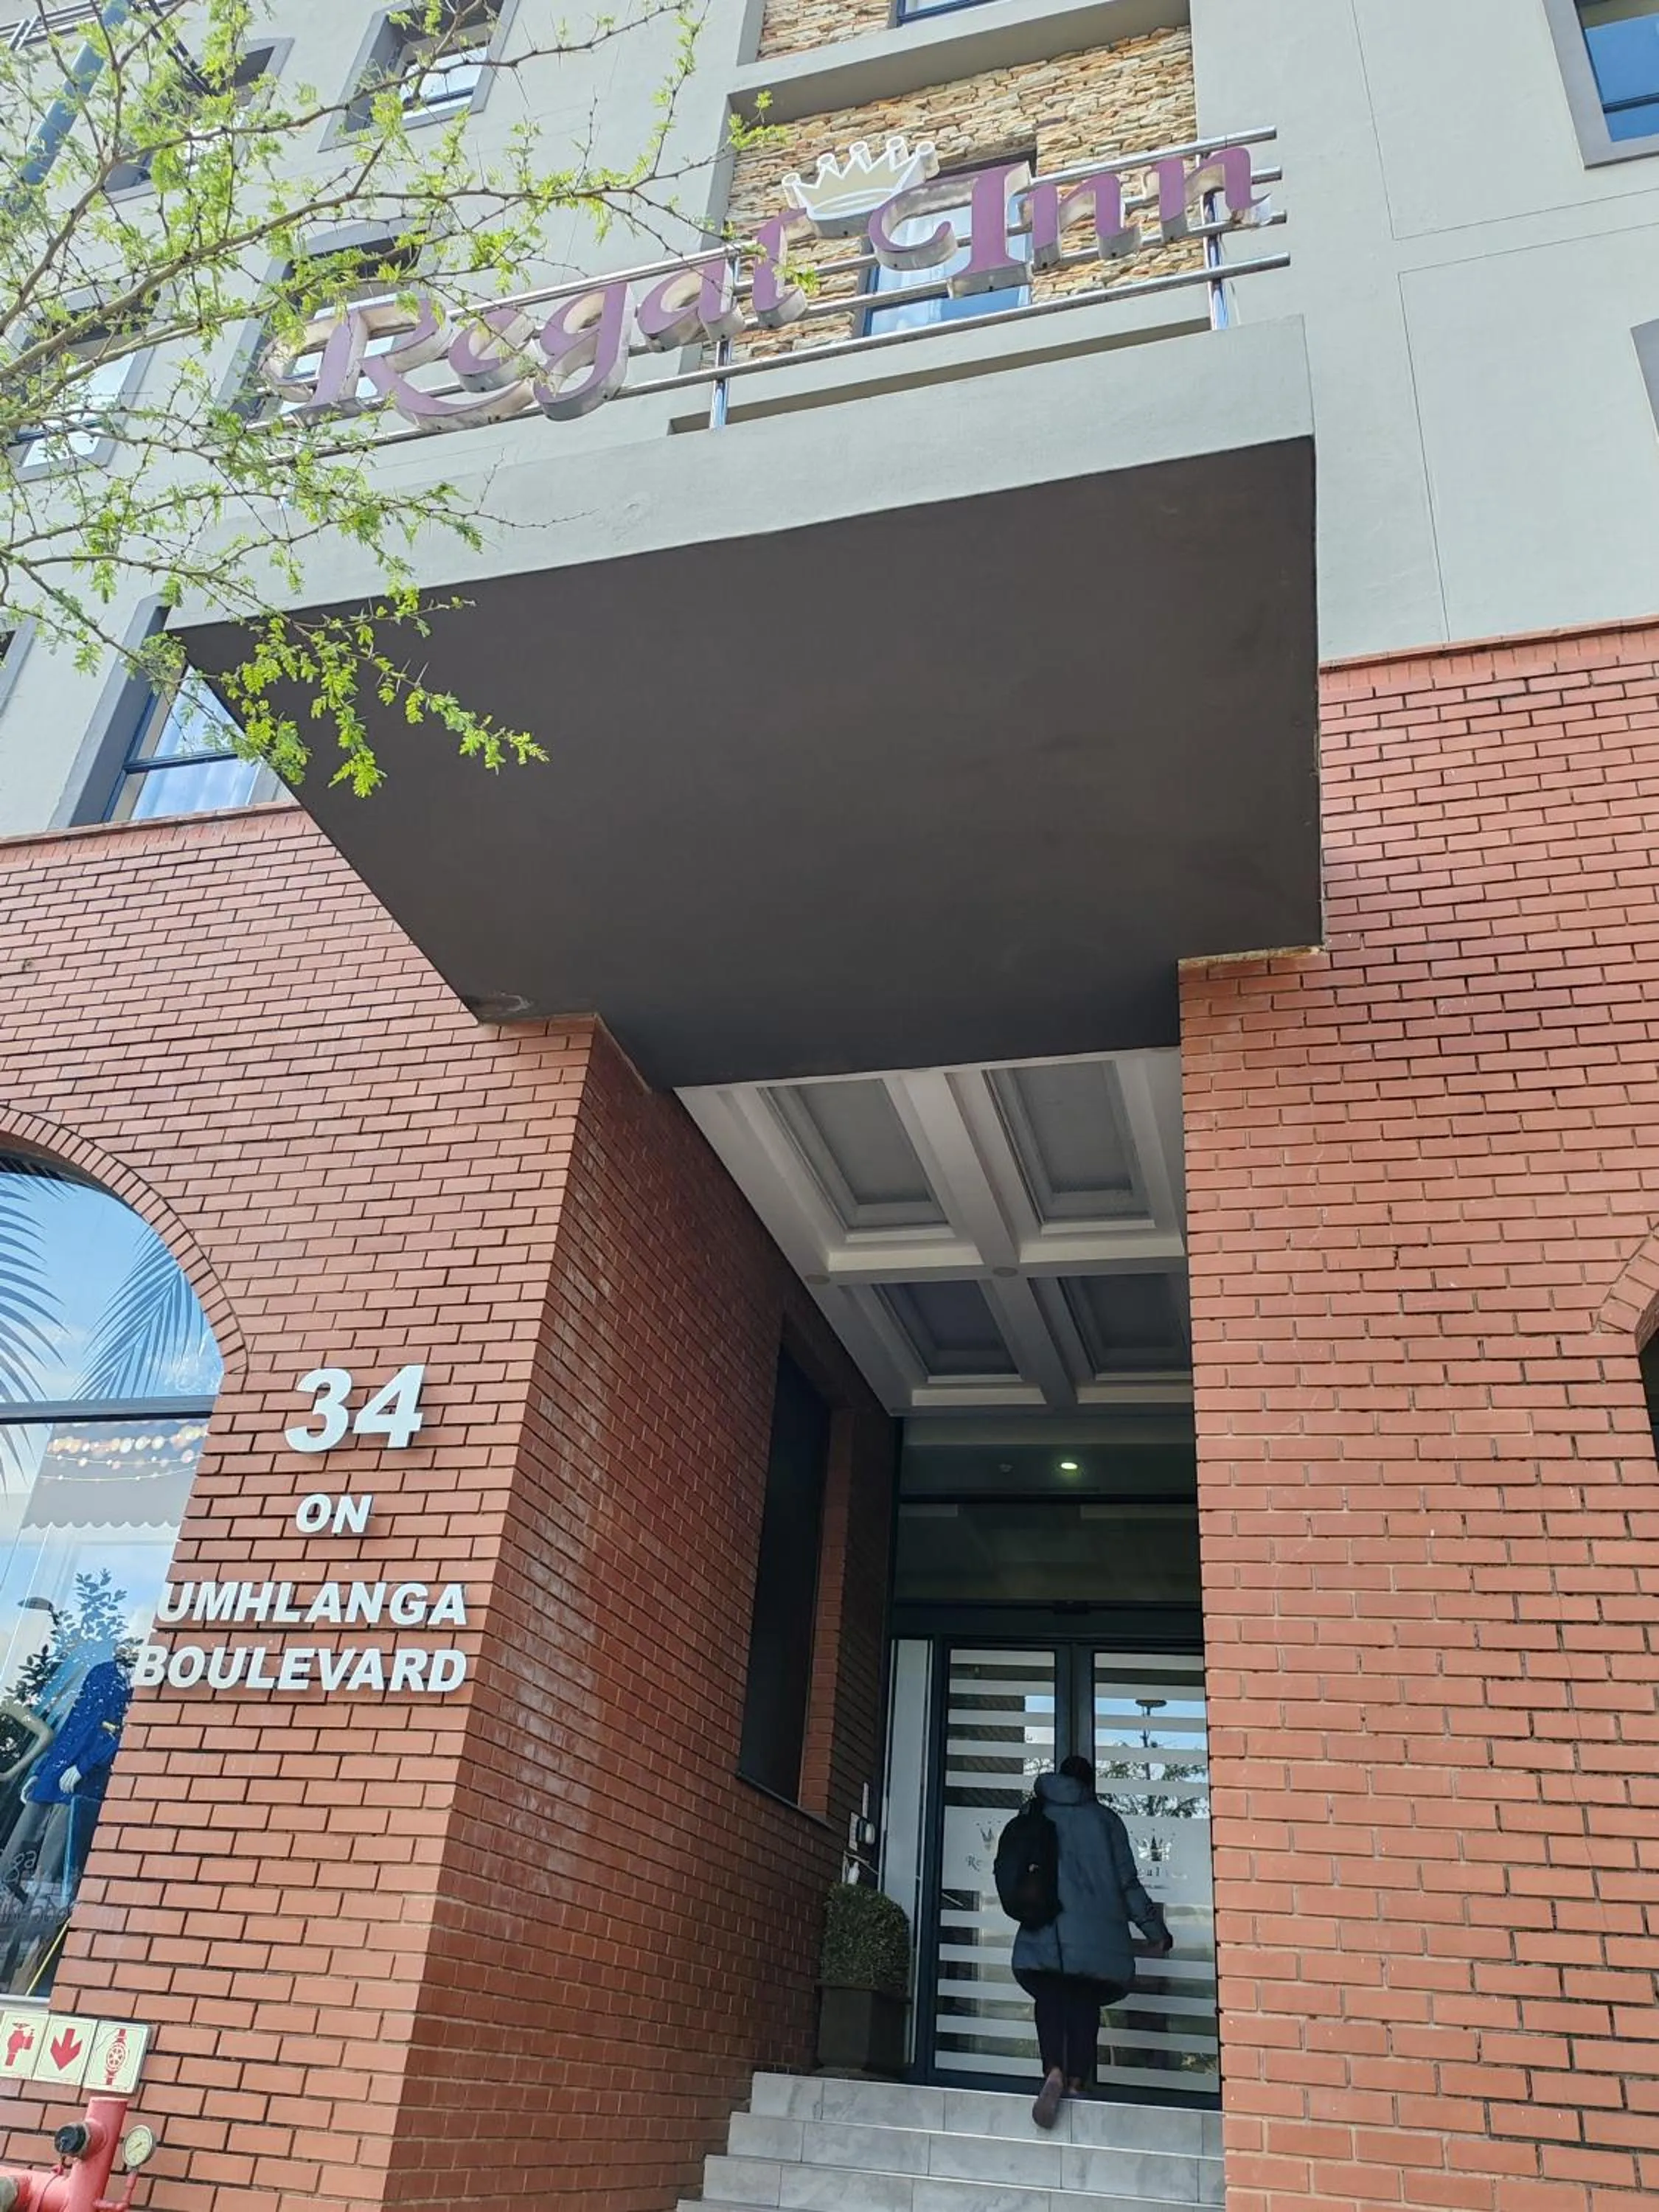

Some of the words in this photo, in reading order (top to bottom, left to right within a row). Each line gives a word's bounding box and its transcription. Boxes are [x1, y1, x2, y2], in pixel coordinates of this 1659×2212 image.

[260, 209, 807, 432] Regal
[869, 147, 1273, 298] Inn
[285, 1365, 425, 1453] 34
[296, 1494, 372, 1534] ON
[156, 1581, 467, 1625] UMHLANGA
[134, 1645, 467, 1692] BOULEVARD
